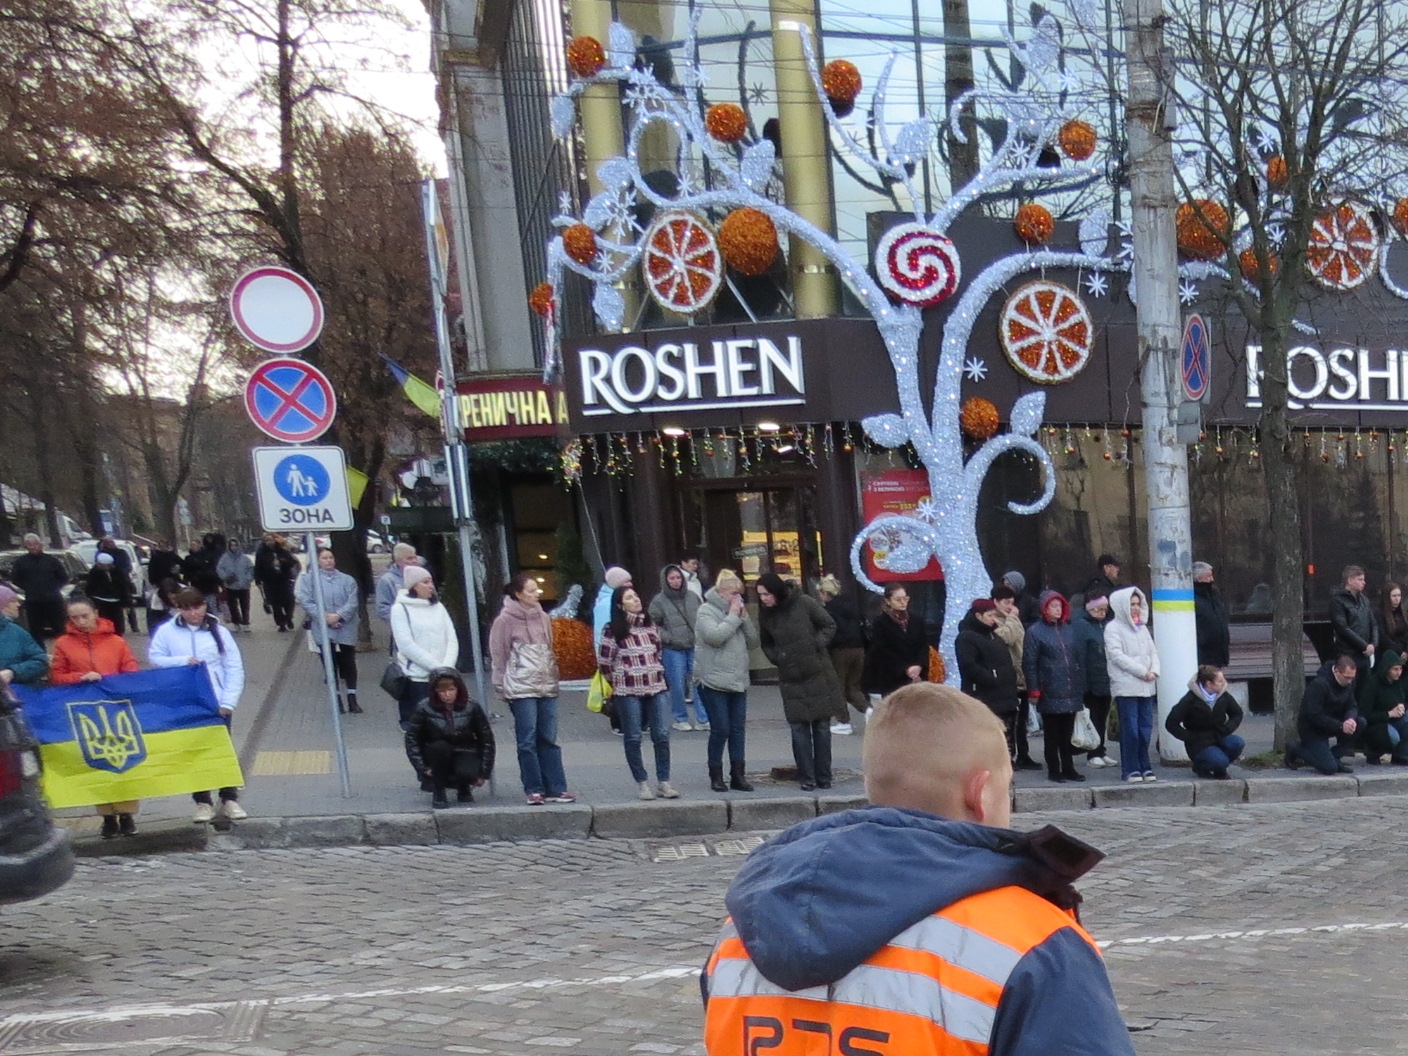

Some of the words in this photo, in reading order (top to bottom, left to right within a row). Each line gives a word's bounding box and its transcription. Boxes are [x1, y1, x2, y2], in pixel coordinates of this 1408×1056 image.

[579, 336, 806, 414] ROSHEN
[460, 390, 552, 428] РЕНИЧНА
[280, 508, 335, 524] ЗОНА
